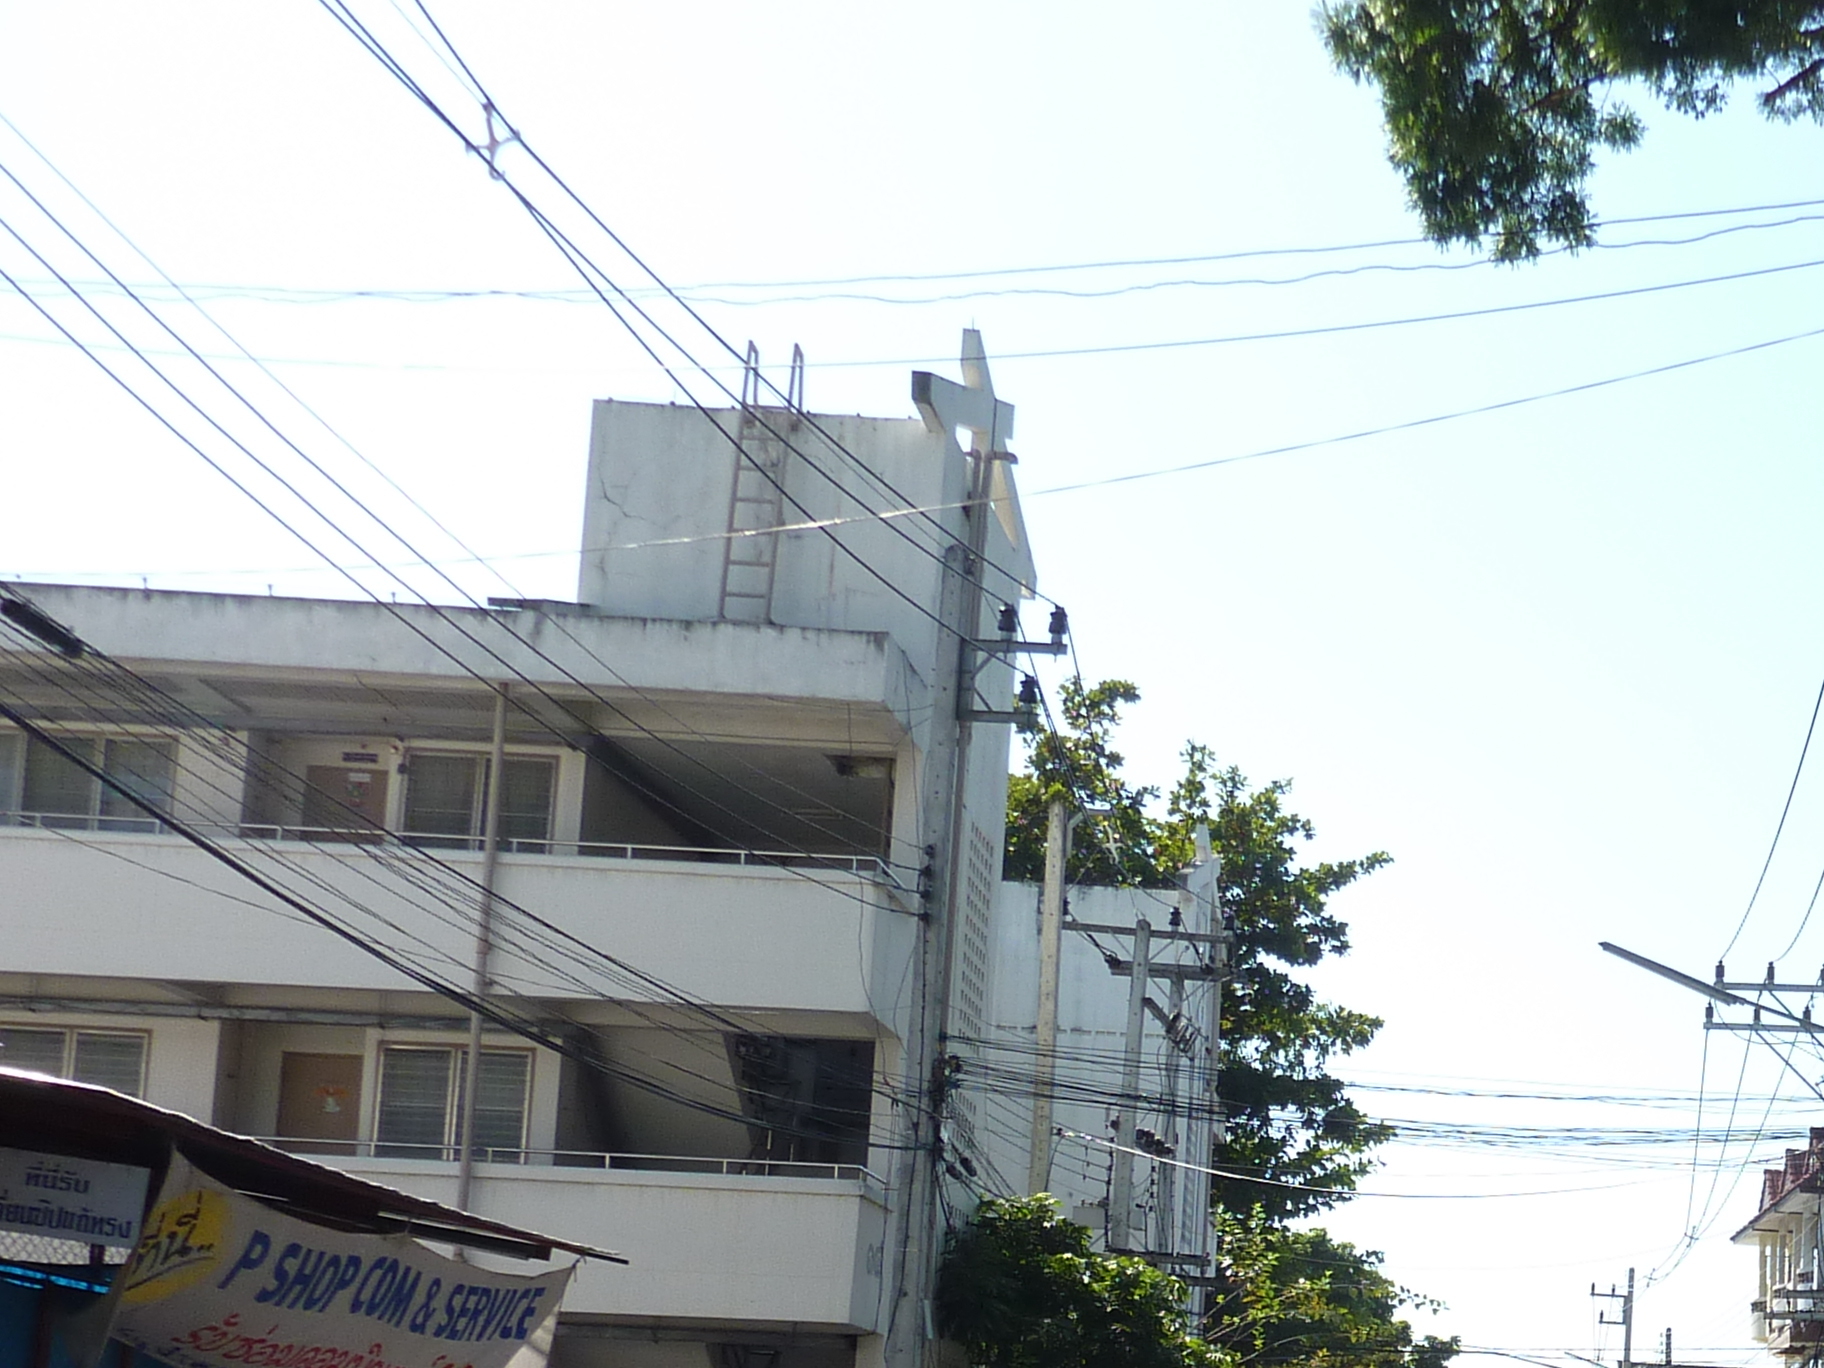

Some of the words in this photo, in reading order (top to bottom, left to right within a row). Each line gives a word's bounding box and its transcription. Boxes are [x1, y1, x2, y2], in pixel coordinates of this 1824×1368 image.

[217, 1229, 271, 1289] P
[254, 1243, 363, 1315] SHOP
[350, 1256, 422, 1328] COM
[410, 1277, 442, 1335] &
[433, 1283, 547, 1342] SERVICE
